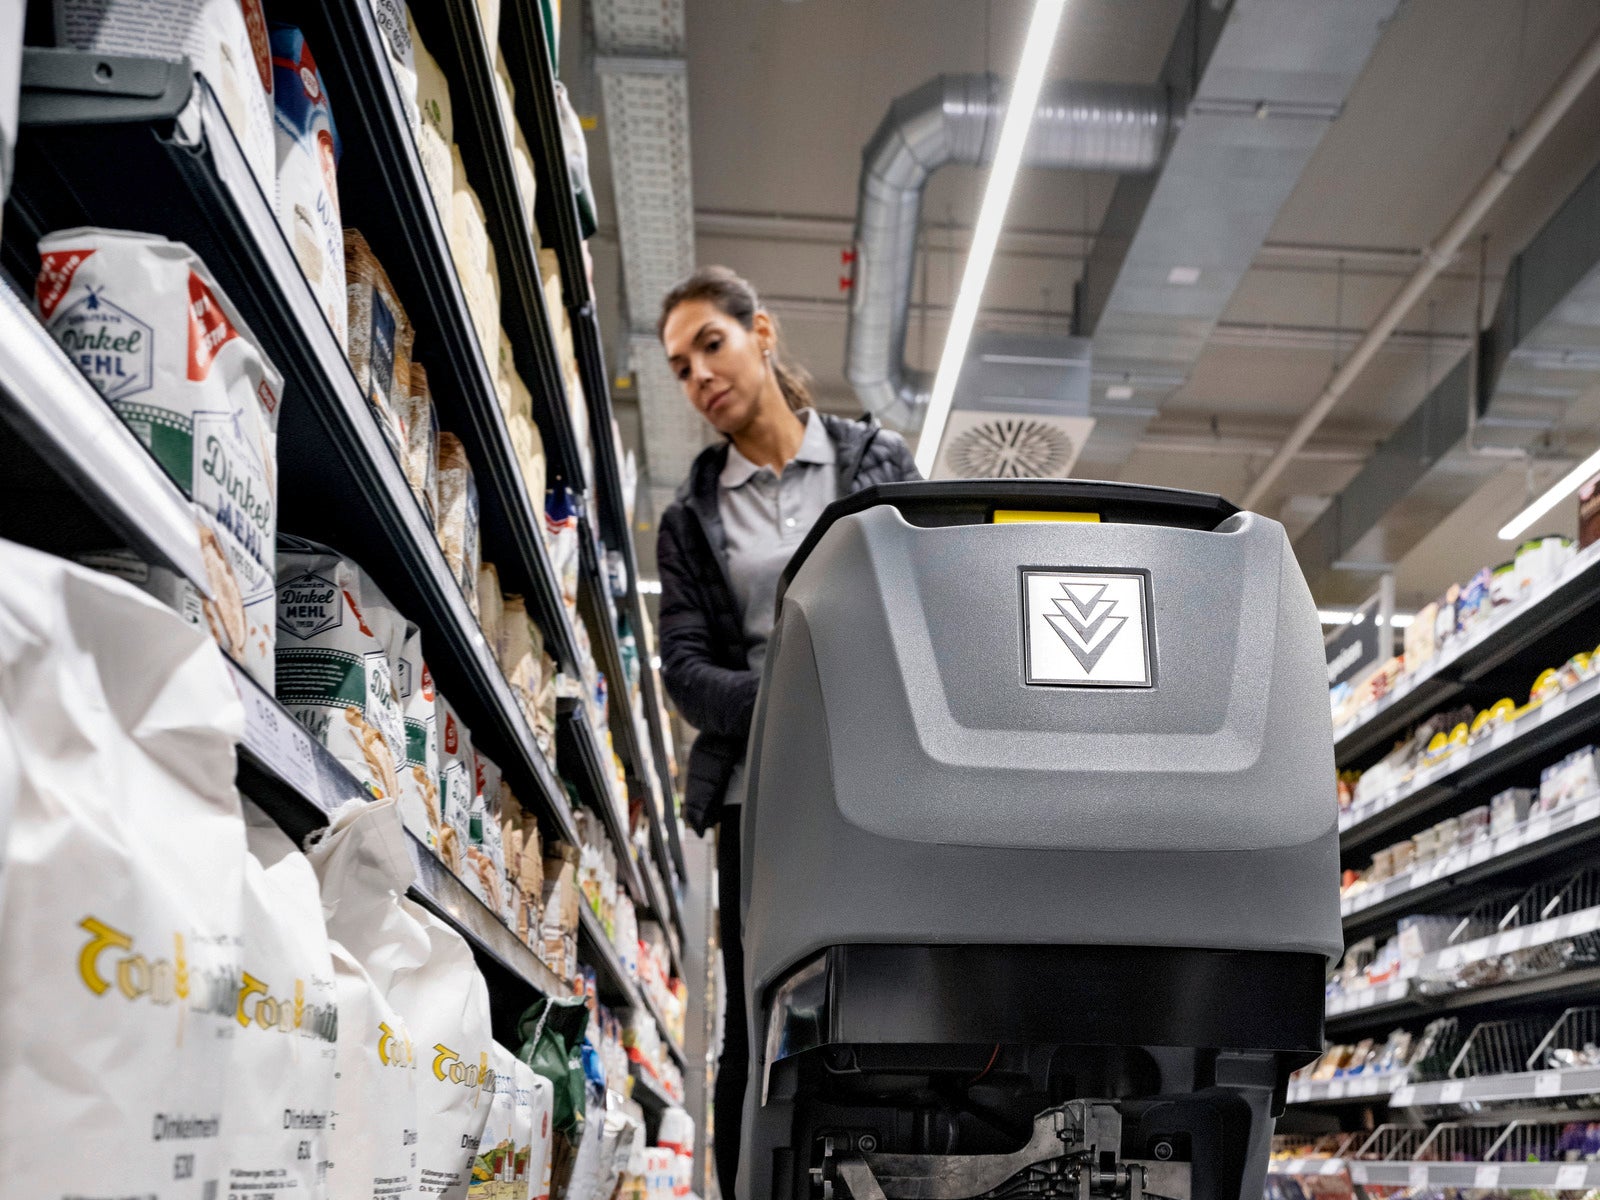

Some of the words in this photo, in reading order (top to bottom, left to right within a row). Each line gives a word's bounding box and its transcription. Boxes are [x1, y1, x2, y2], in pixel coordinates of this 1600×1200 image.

[62, 325, 142, 354] Dinkel
[80, 355, 127, 377] EHL
[202, 434, 270, 538] Dinkel
[216, 493, 263, 566] MEHL
[281, 589, 335, 605] Dinkel
[286, 606, 326, 619] MEHL
